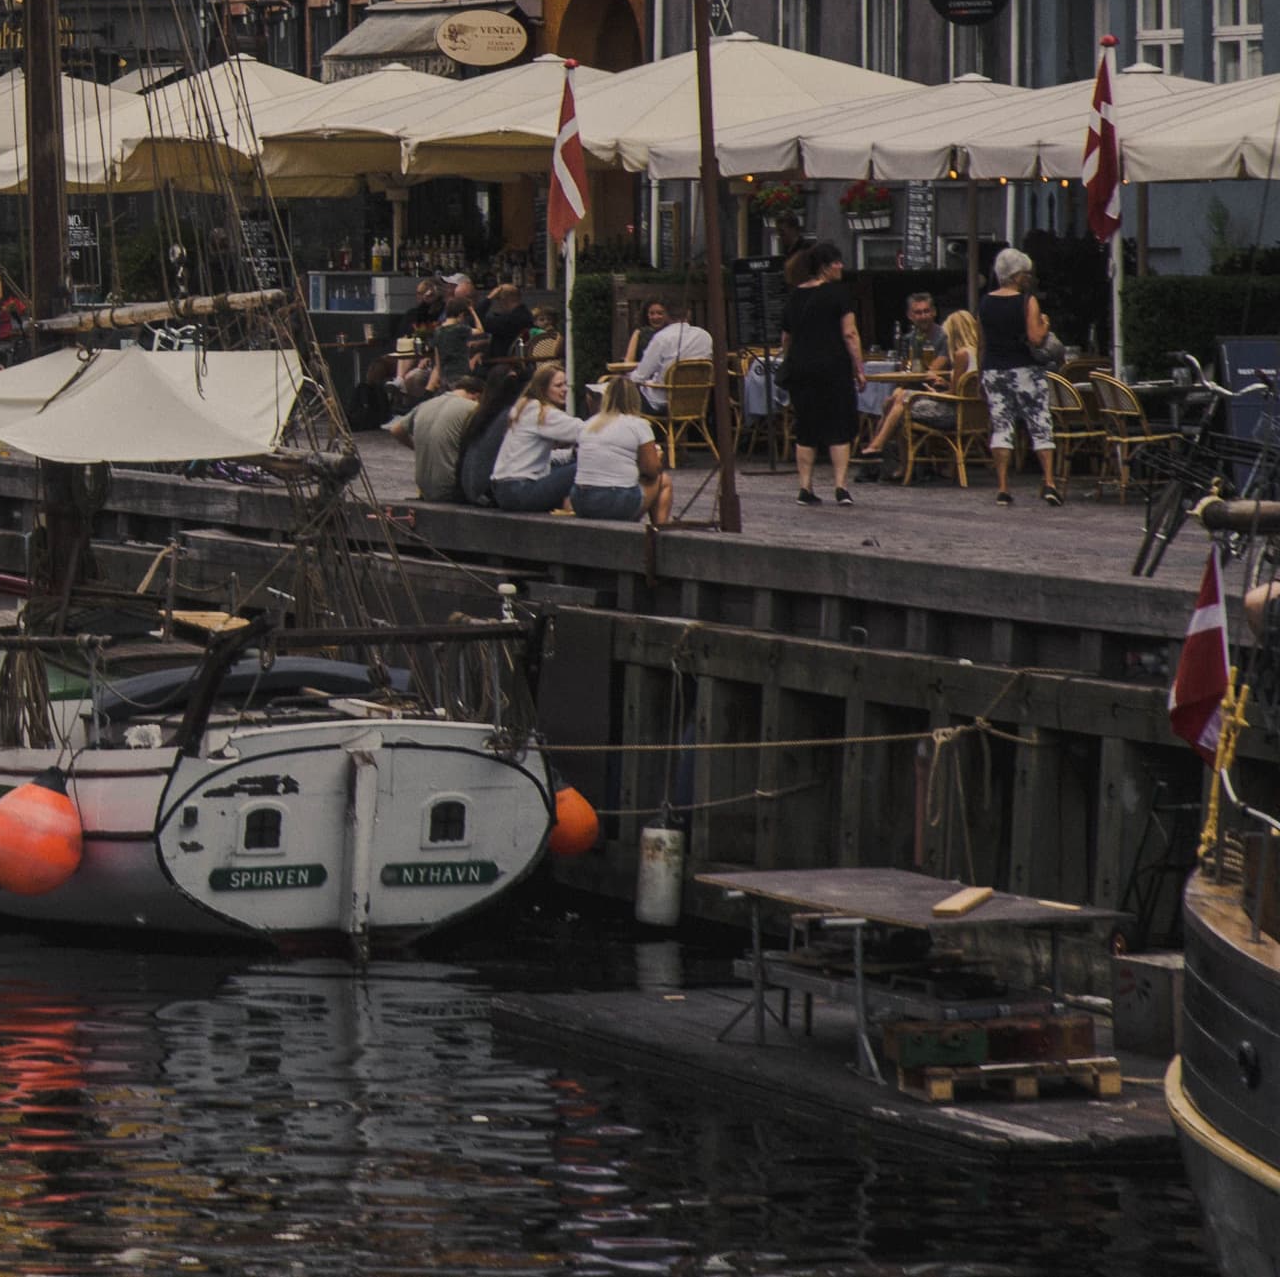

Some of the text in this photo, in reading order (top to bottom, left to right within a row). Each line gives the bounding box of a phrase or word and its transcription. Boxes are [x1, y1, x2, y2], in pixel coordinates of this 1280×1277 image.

[479, 26, 522, 35] VENEZIA
[229, 865, 481, 888] SPURVEN NYHAVN
